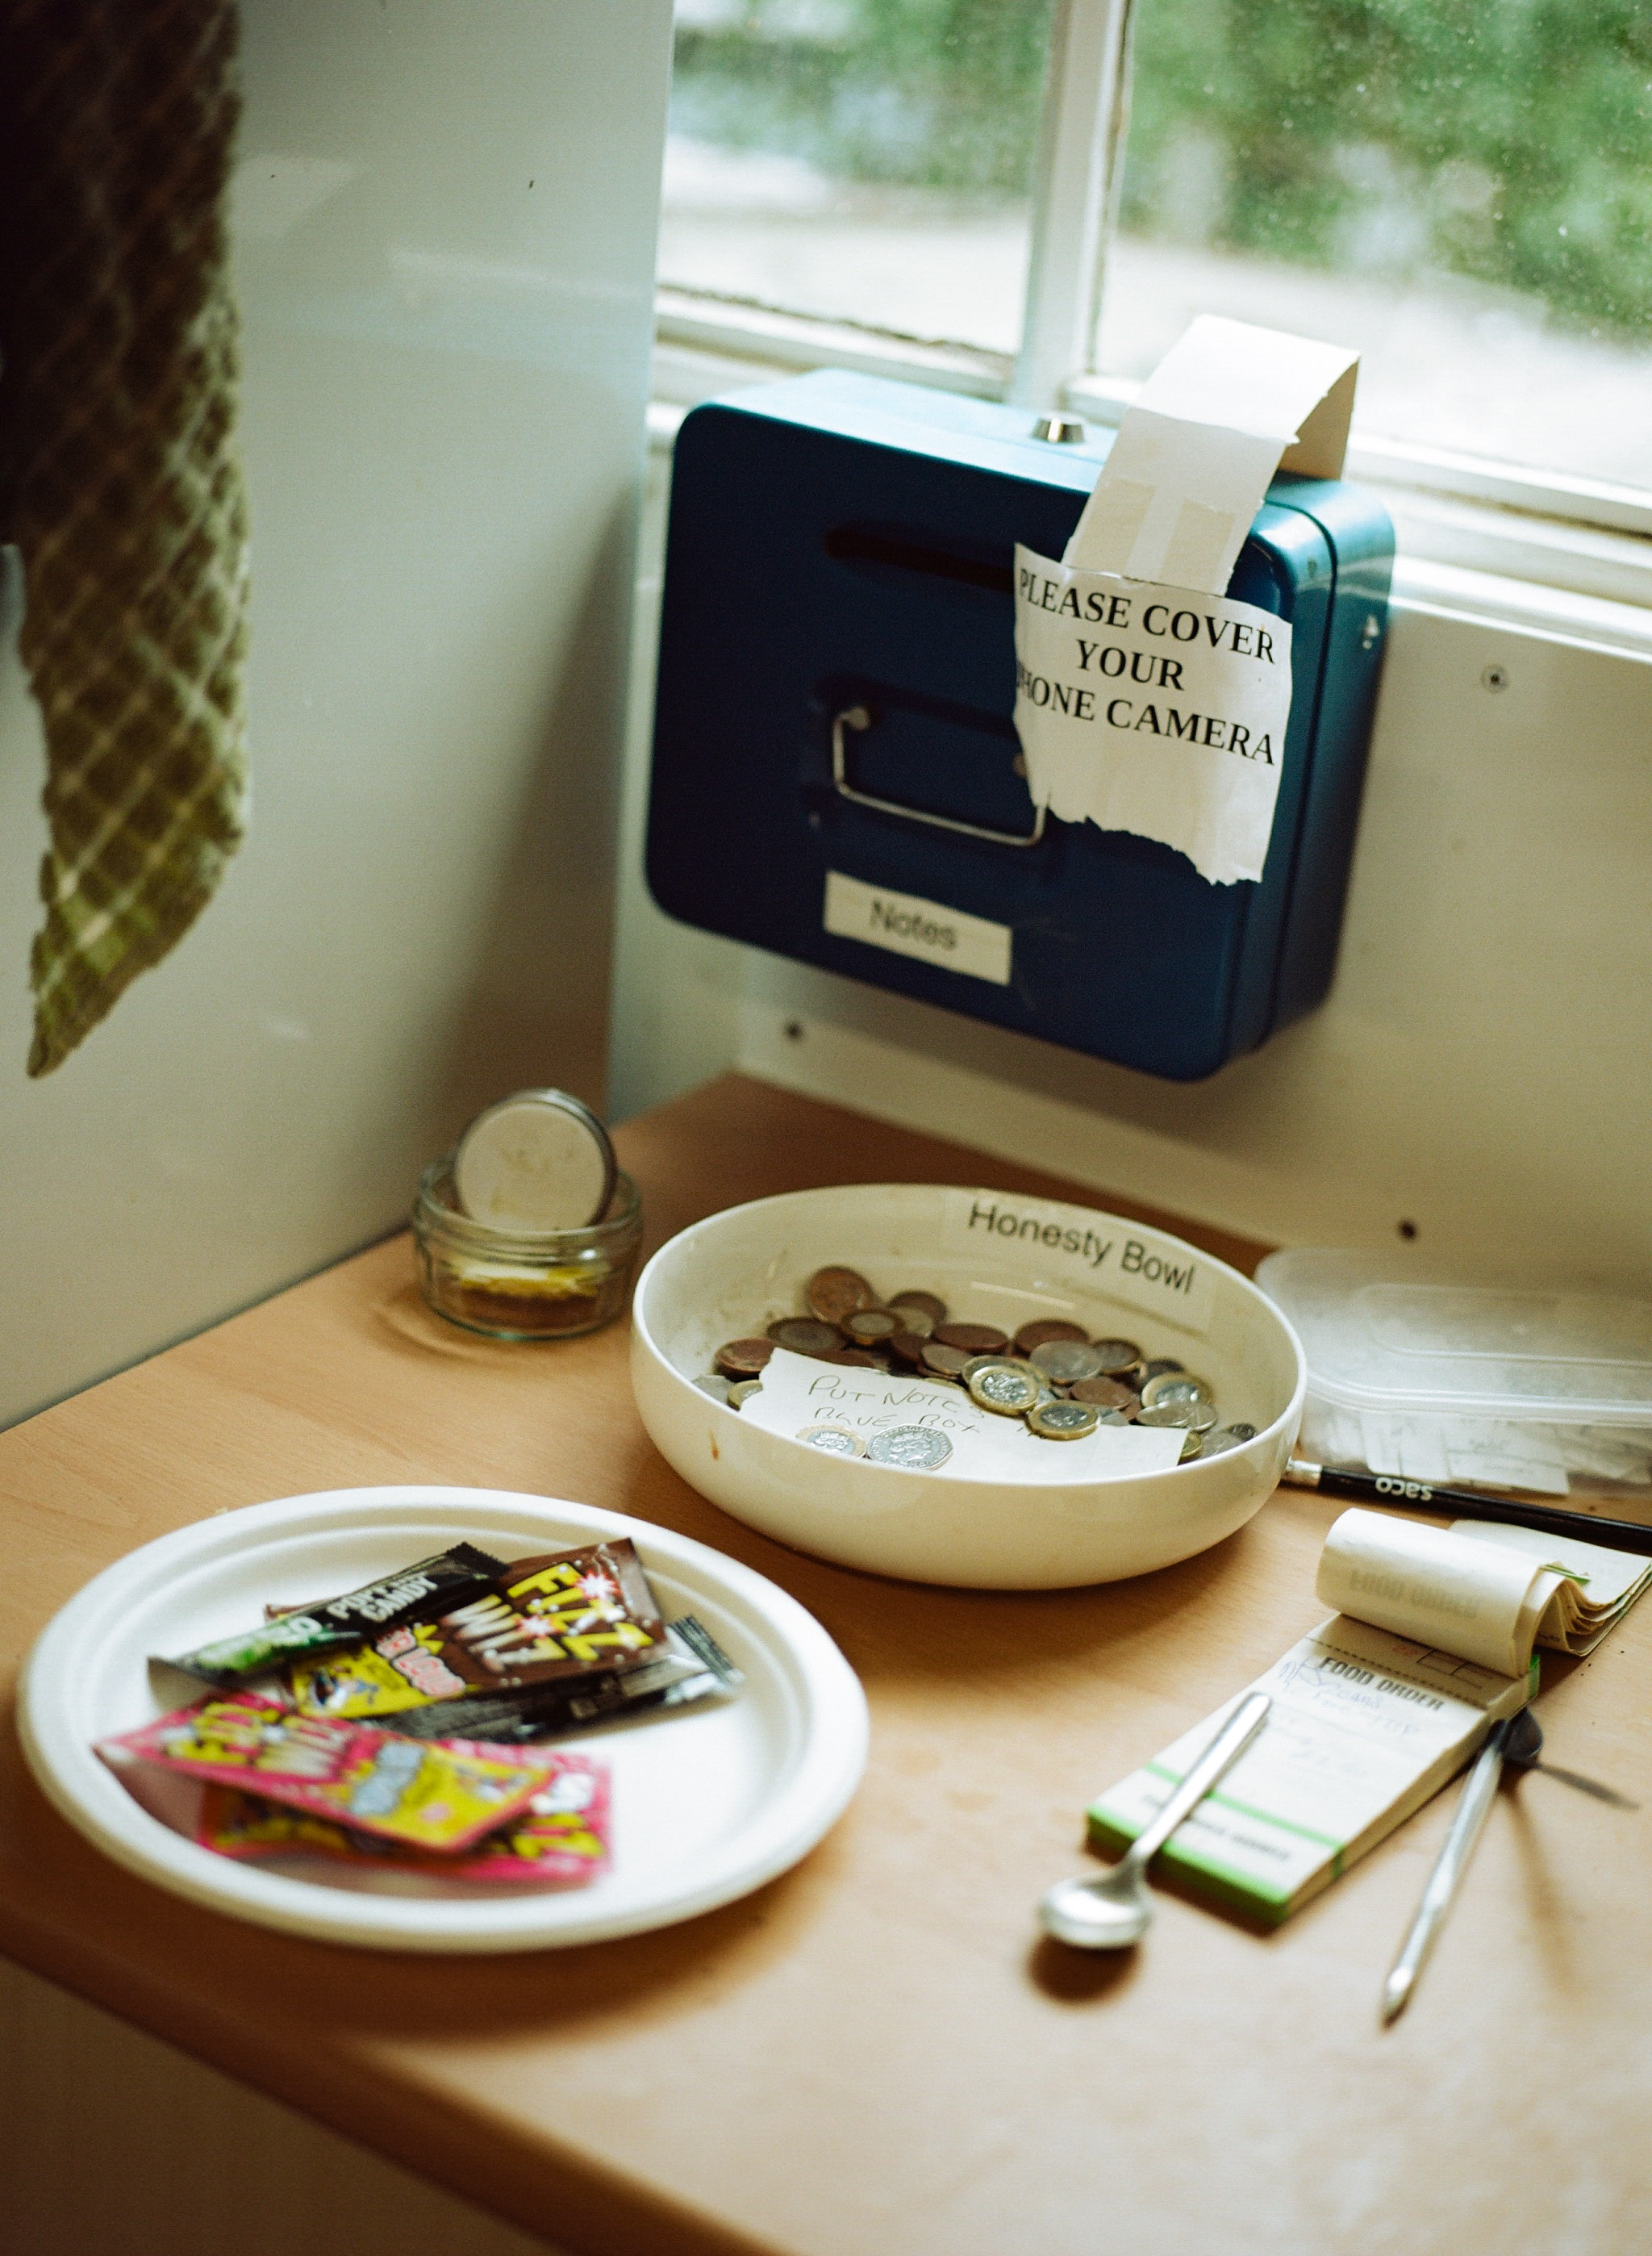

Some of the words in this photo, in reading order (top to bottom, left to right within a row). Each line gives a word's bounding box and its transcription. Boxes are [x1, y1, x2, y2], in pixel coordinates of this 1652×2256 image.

[1020, 568, 1132, 629] PLEASE
[1142, 604, 1276, 665] COVER
[1075, 638, 1186, 692] YOUR
[1106, 699, 1276, 767] CAMERA
[870, 896, 958, 952] Notes
[969, 1201, 1113, 1268] Honesty
[1119, 1239, 1197, 1295] Bowl
[1317, 1656, 1375, 1686] FOOD
